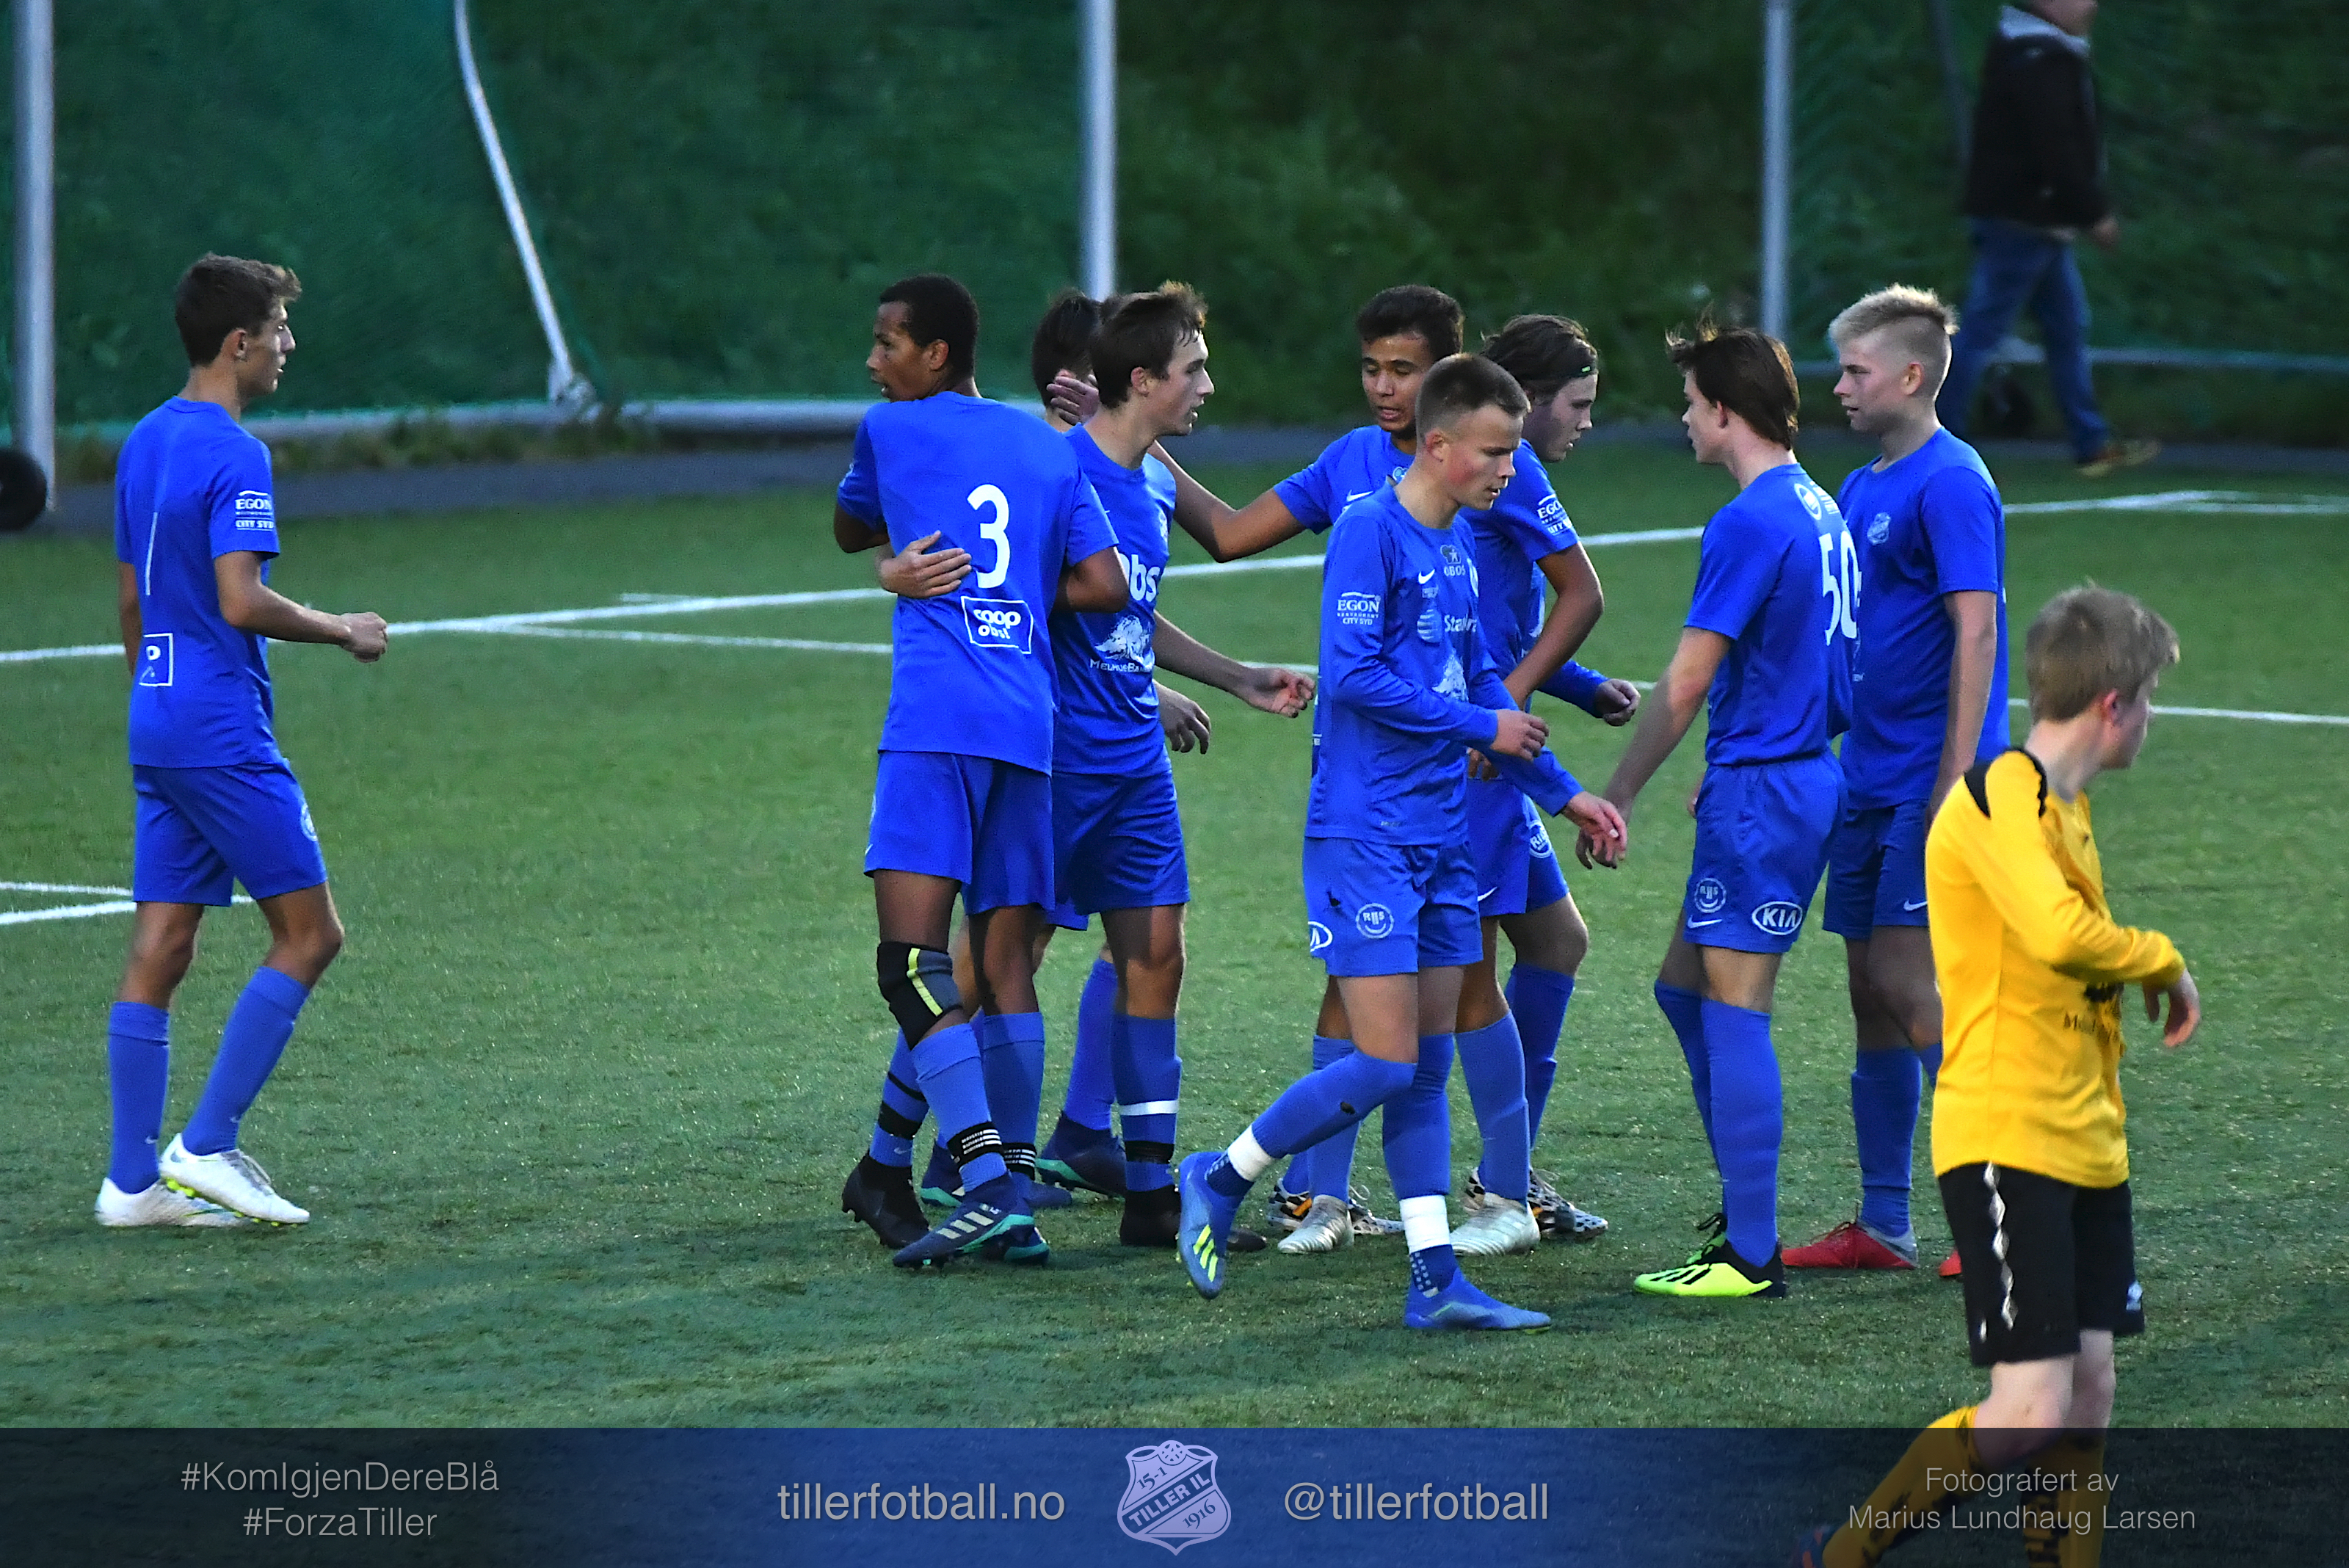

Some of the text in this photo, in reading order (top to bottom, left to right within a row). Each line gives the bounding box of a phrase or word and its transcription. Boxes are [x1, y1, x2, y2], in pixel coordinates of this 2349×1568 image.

[1536, 500, 1564, 519] EGO
[966, 484, 1010, 588] 3
[1818, 530, 1859, 646] 50
[1337, 599, 1380, 613] EGON
[973, 609, 1021, 629] coop
[1762, 907, 1797, 928] KIA
